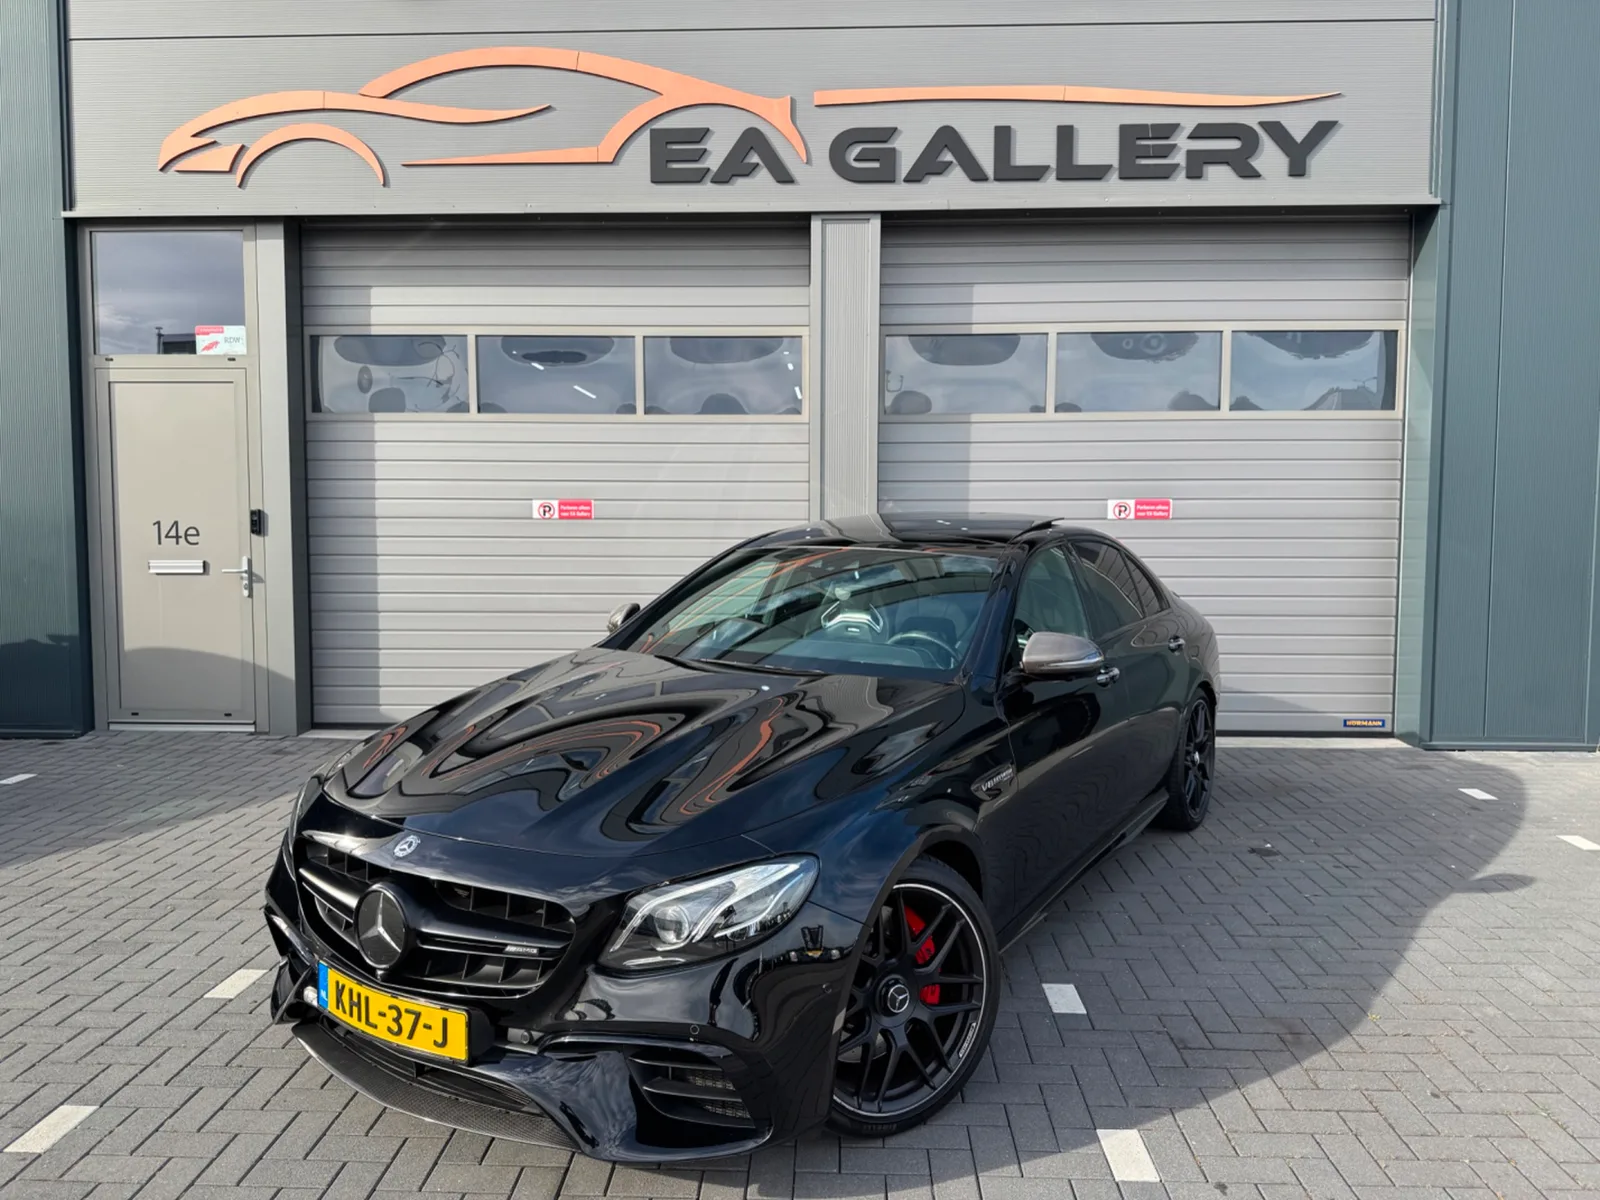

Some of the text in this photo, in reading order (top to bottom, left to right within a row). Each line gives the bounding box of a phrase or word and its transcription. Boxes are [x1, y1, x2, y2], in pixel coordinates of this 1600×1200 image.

[650, 120, 1340, 184] EA GALLERY
[152, 520, 200, 546] 14e
[335, 980, 448, 1048] KHL-37-J
